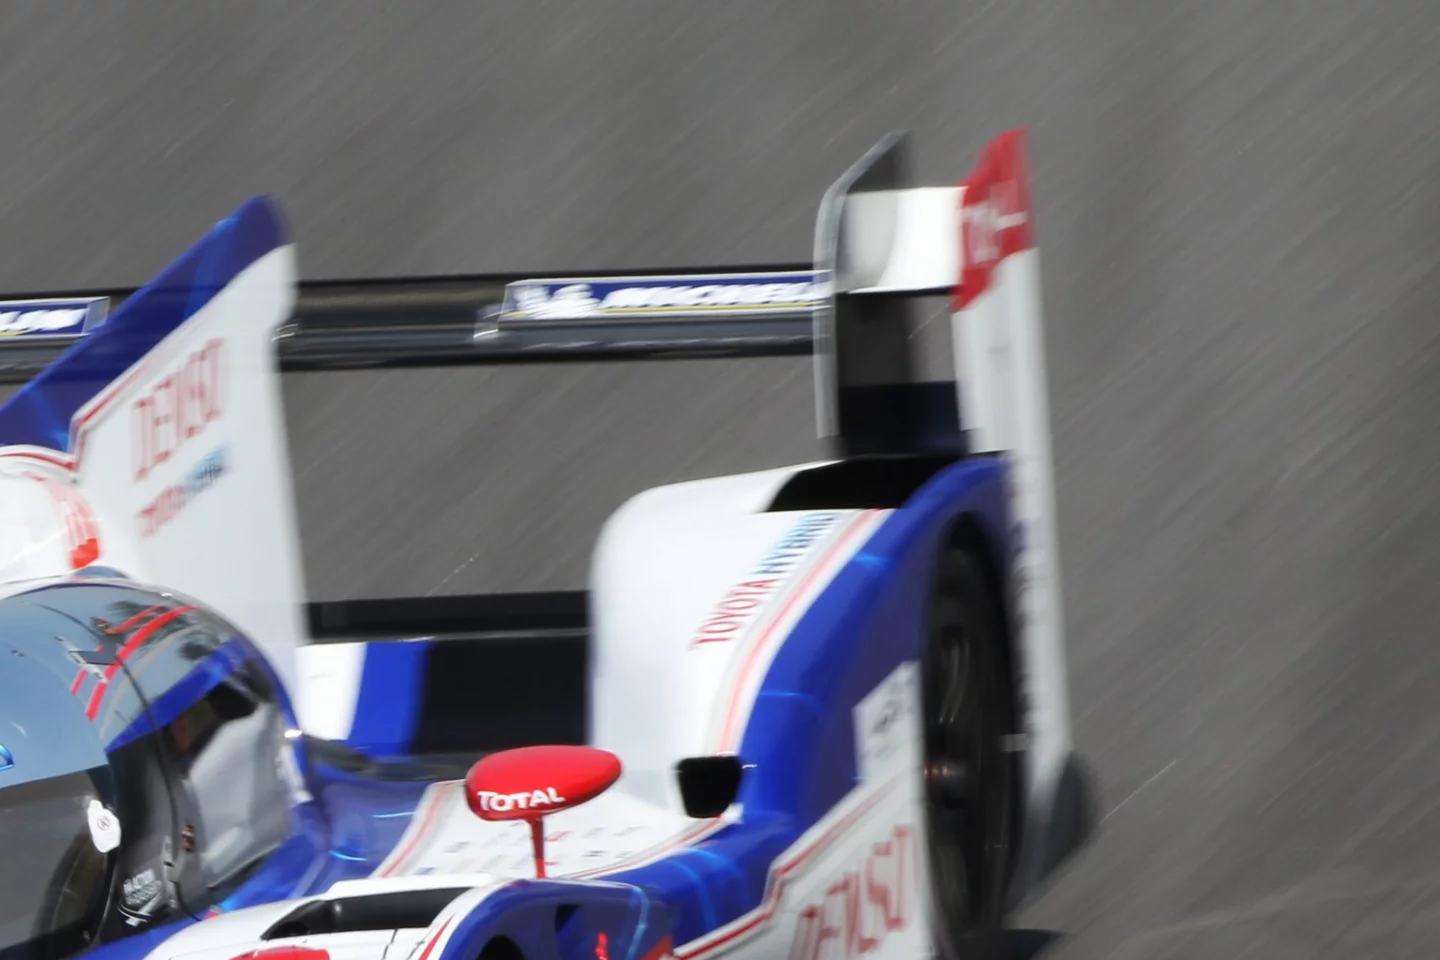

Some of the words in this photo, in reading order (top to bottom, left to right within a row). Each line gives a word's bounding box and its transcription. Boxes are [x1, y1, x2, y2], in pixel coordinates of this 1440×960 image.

[599, 283, 832, 309] MICHEL
[687, 577, 781, 650] TOYOTA
[748, 512, 838, 575] HYBRID
[477, 786, 566, 812] TOTAL
